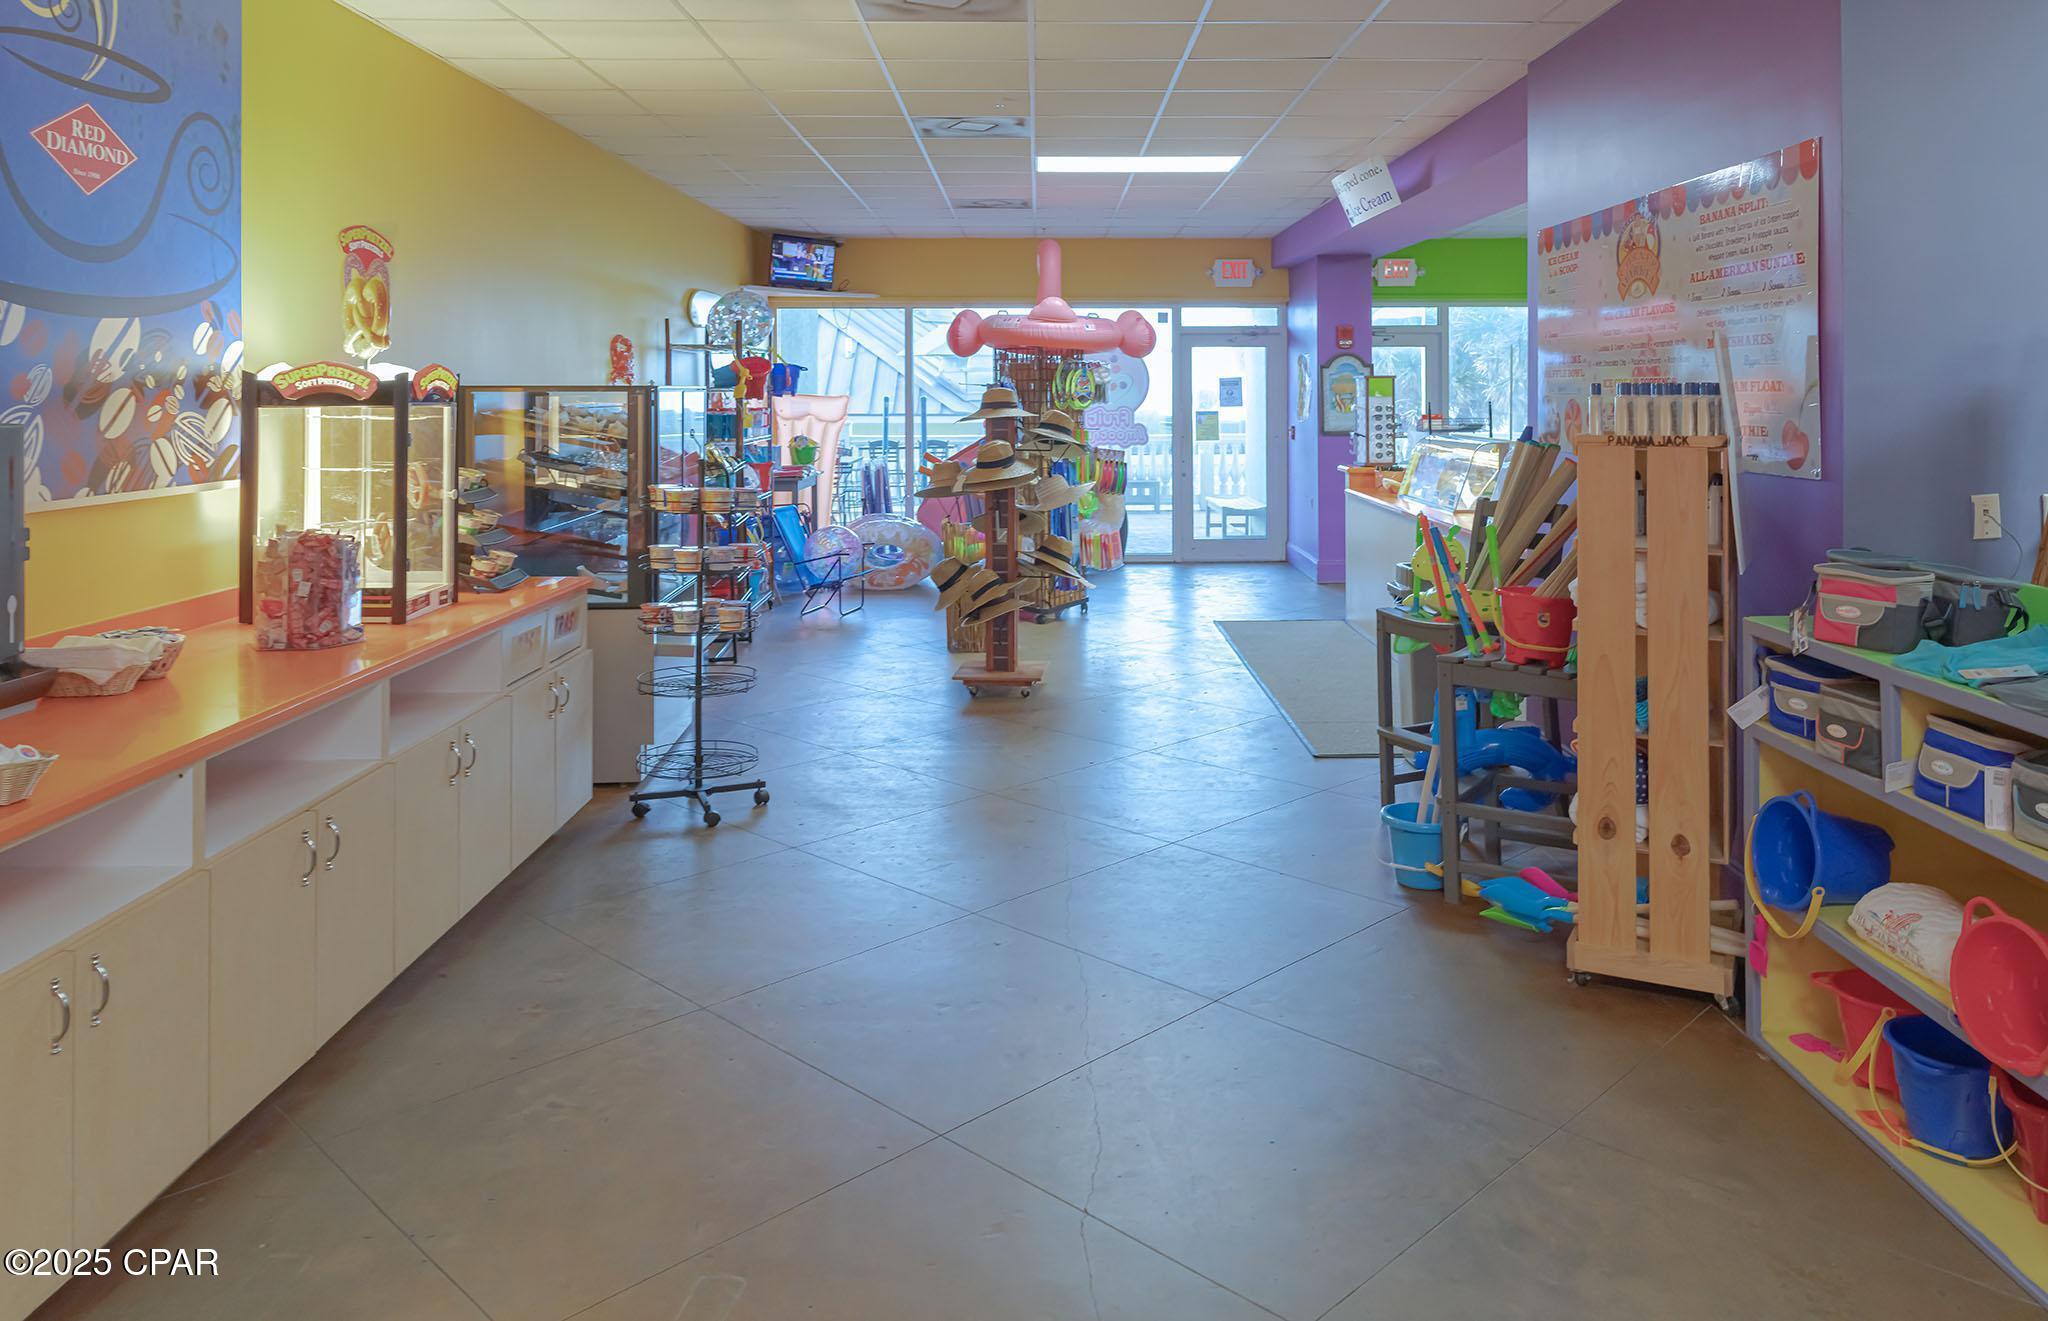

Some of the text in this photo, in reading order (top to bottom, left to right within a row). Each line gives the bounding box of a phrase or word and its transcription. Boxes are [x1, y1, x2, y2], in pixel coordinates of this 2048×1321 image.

[71, 118, 106, 143] RED
[46, 130, 129, 166] DIAMOND
[1359, 191, 1393, 212] Cream
[1699, 198, 1768, 225] BANANA SPLIT:
[1221, 261, 1249, 279] EXIT
[1383, 260, 1411, 279] EXIT
[1689, 262, 1758, 283] ALL-AMERICAN
[272, 362, 372, 390] SUPERPRETZEL
[294, 377, 356, 391] SOFT PRETZELS
[1750, 380, 1784, 392] FLOAT:
[1608, 435, 1690, 446] PANAMA JACK
